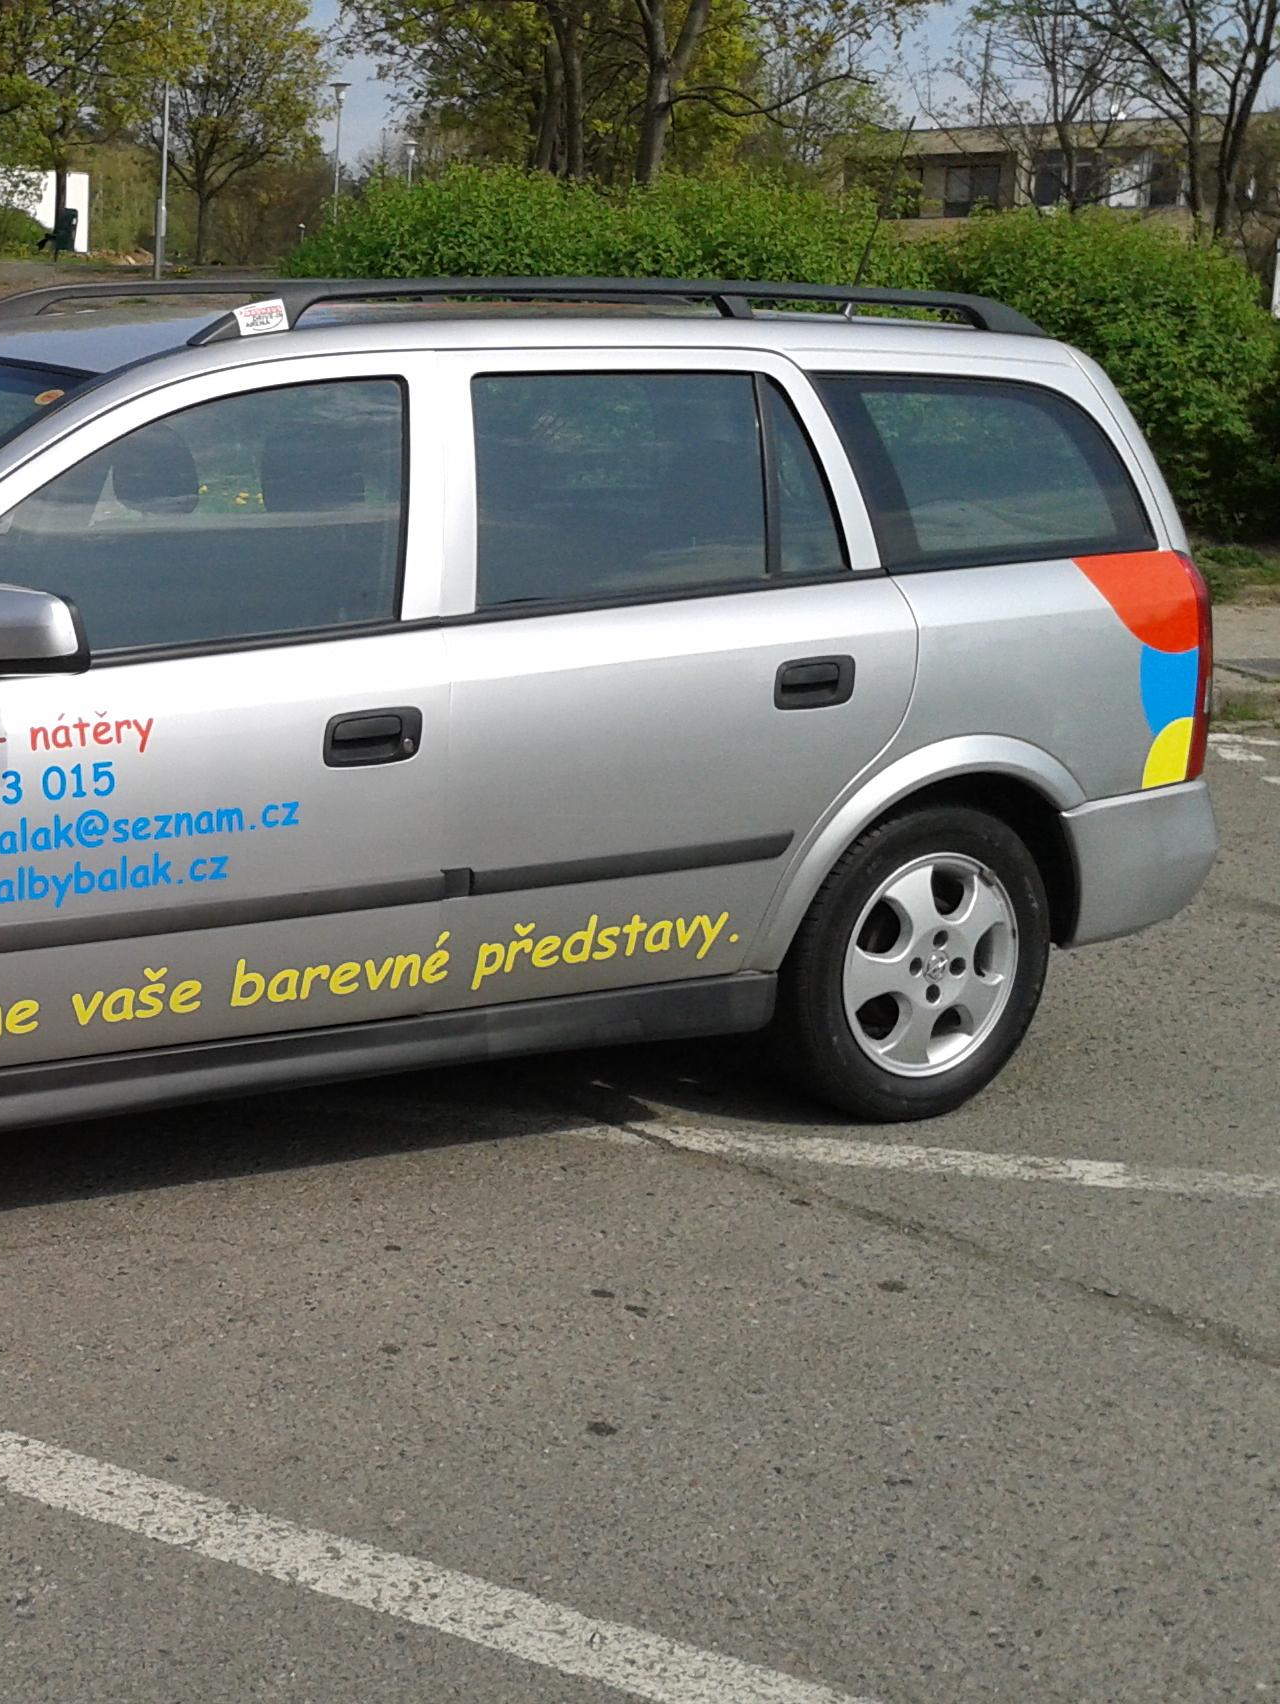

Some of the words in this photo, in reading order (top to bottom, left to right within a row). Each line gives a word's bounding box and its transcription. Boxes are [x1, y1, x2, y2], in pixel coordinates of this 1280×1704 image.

[30, 712, 154, 753] nátěry
[41, 761, 116, 801] 015
[71, 967, 202, 1025] vaše
[230, 930, 451, 1007] barevné
[470, 911, 740, 990] představy.
